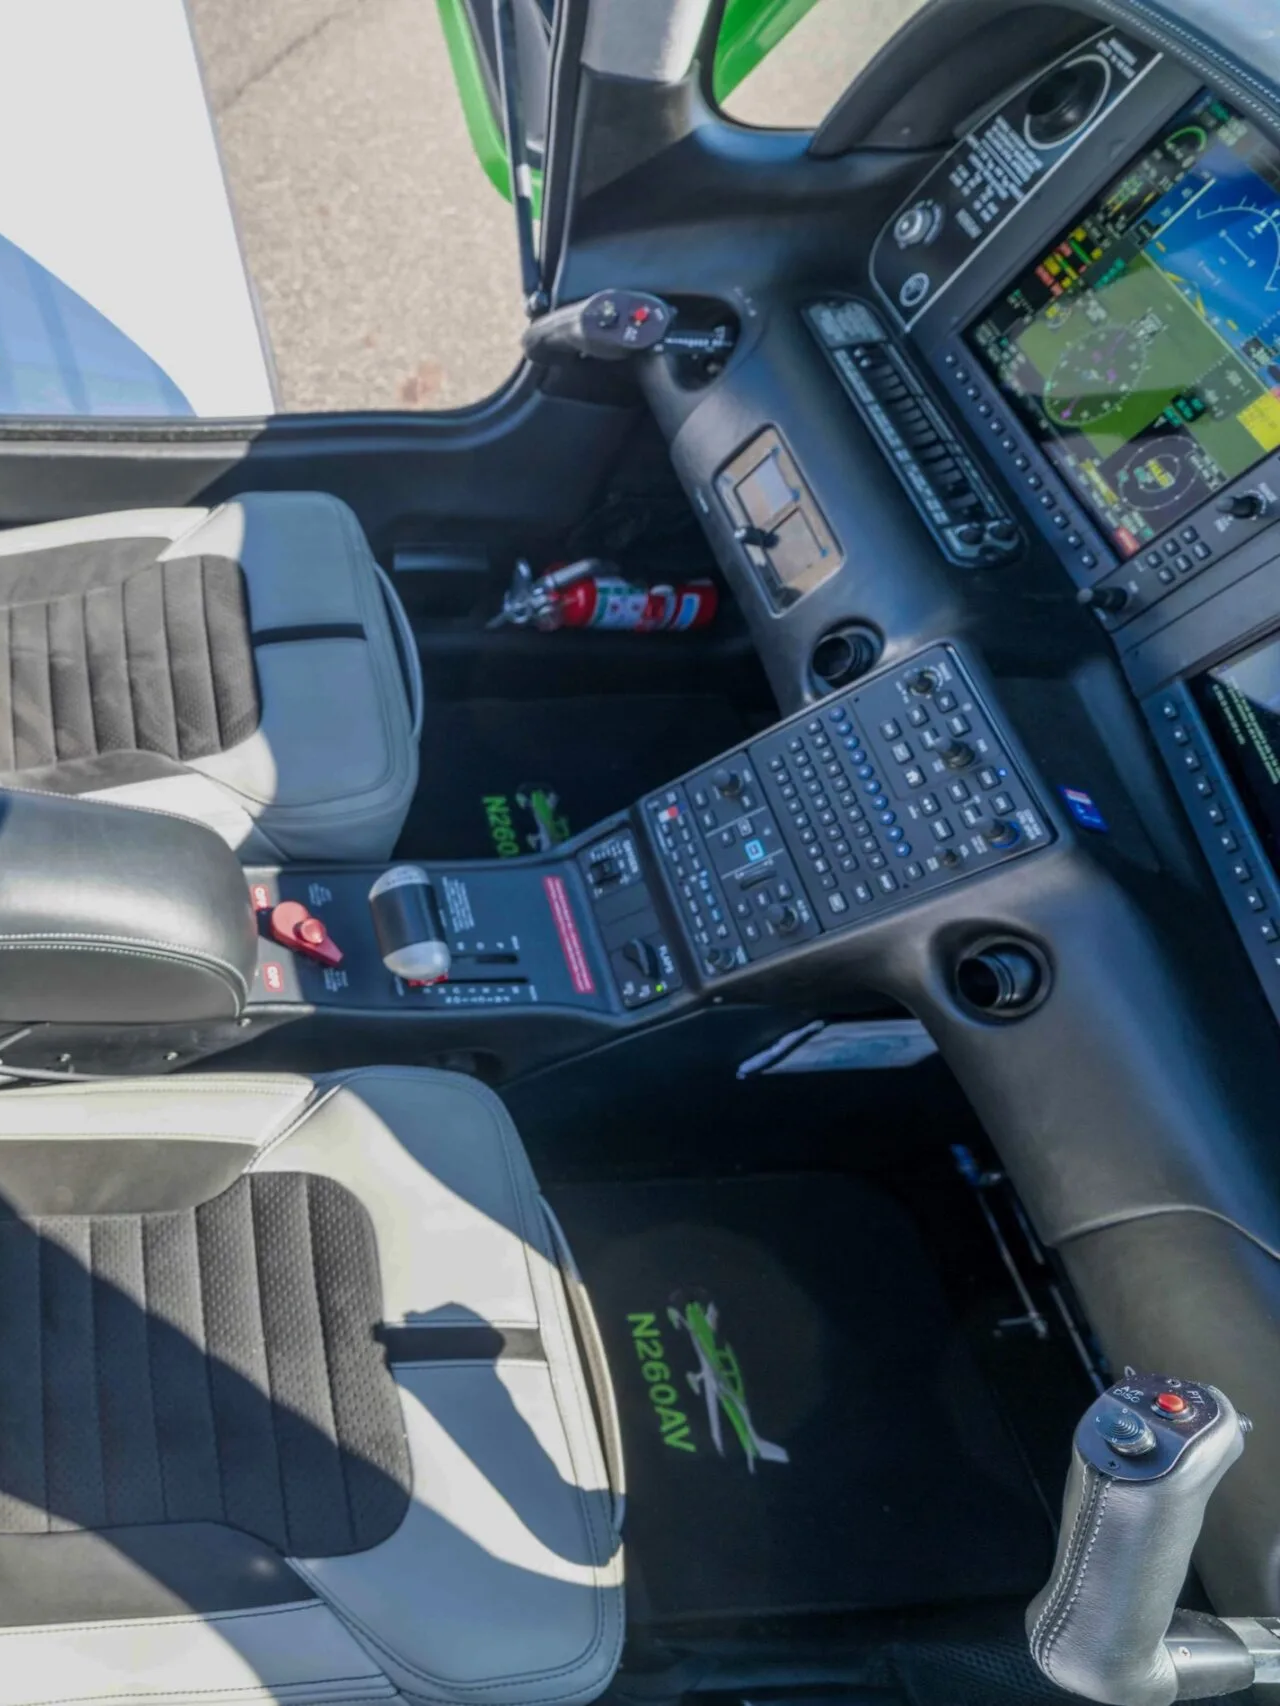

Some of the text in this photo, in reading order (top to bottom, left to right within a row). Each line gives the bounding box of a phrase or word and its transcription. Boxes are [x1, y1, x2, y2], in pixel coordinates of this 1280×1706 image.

[658, 945, 675, 974] FLAPS
[626, 1312, 696, 1454] N260AV
[1112, 1387, 1140, 1403] DISC
[1186, 1390, 1205, 1404] PTT
